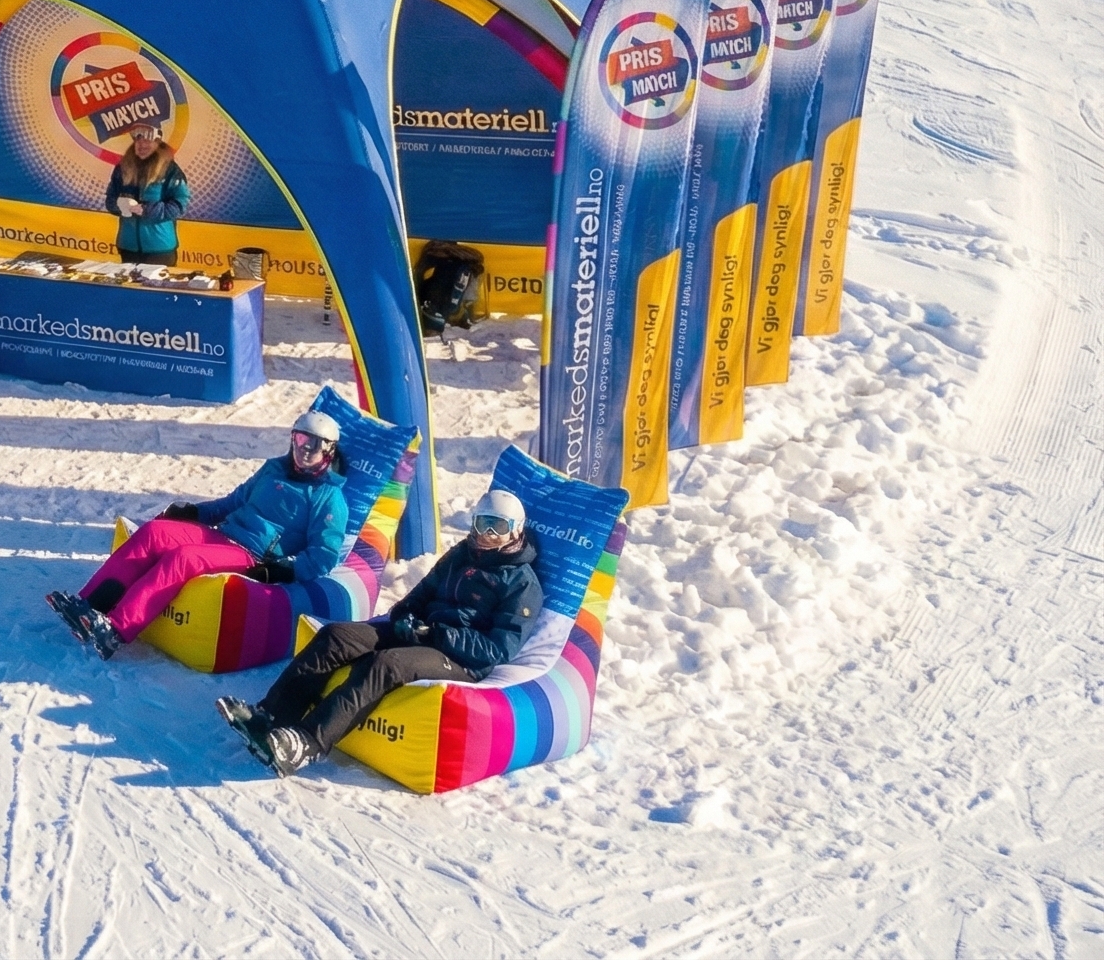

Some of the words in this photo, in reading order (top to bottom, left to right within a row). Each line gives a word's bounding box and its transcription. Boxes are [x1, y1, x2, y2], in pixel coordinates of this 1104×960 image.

[708, 12, 740, 33] RIS
[618, 46, 664, 72] PRIS
[74, 72, 131, 105] PRIS
[814, 288, 829, 304] Vi
[757, 336, 773, 354] Vi
[709, 391, 724, 409] Vi
[631, 452, 647, 473] Vi
